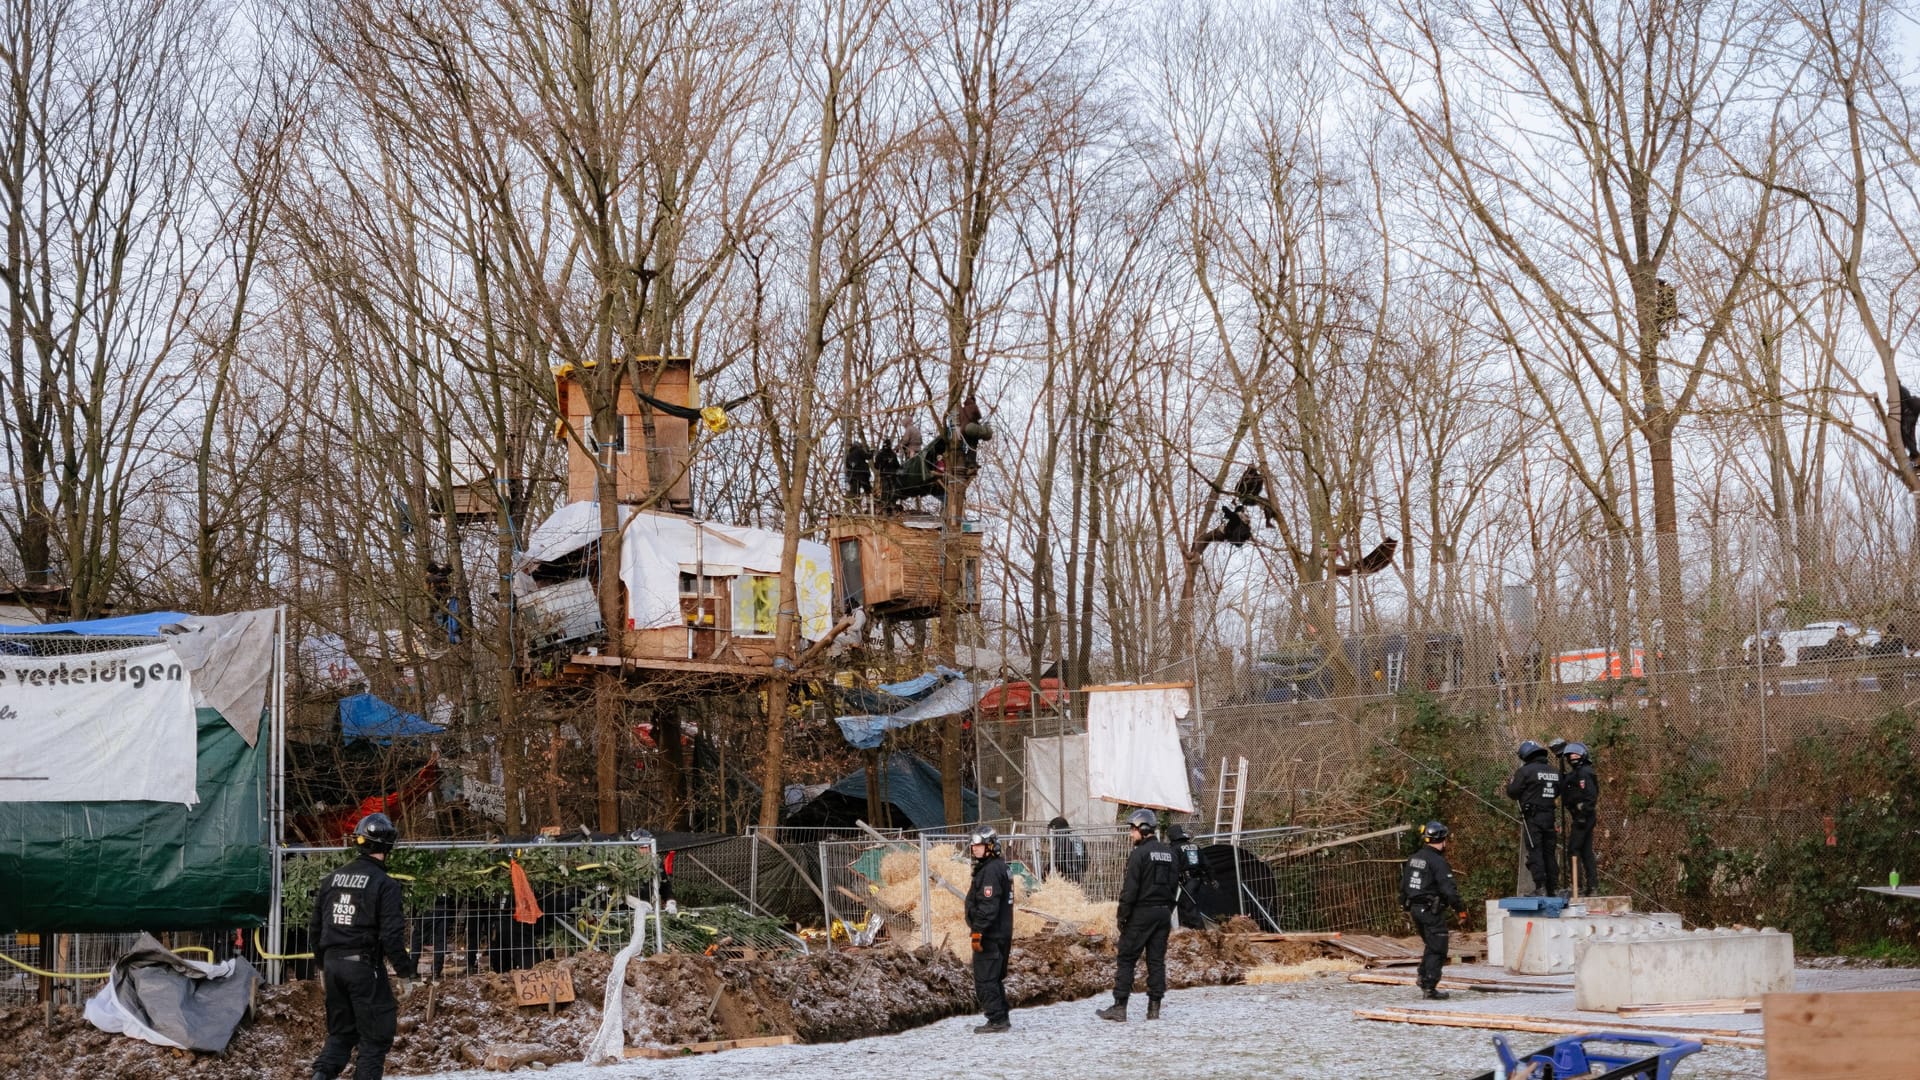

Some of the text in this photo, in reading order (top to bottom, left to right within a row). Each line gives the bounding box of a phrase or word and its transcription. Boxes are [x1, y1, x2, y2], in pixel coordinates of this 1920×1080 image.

[15, 659, 182, 689] verteidigen
[331, 873, 370, 889] POLIZEI
[340, 893, 352, 904] NI
[332, 903, 356, 915] 7830
[332, 913, 353, 925] TEE
